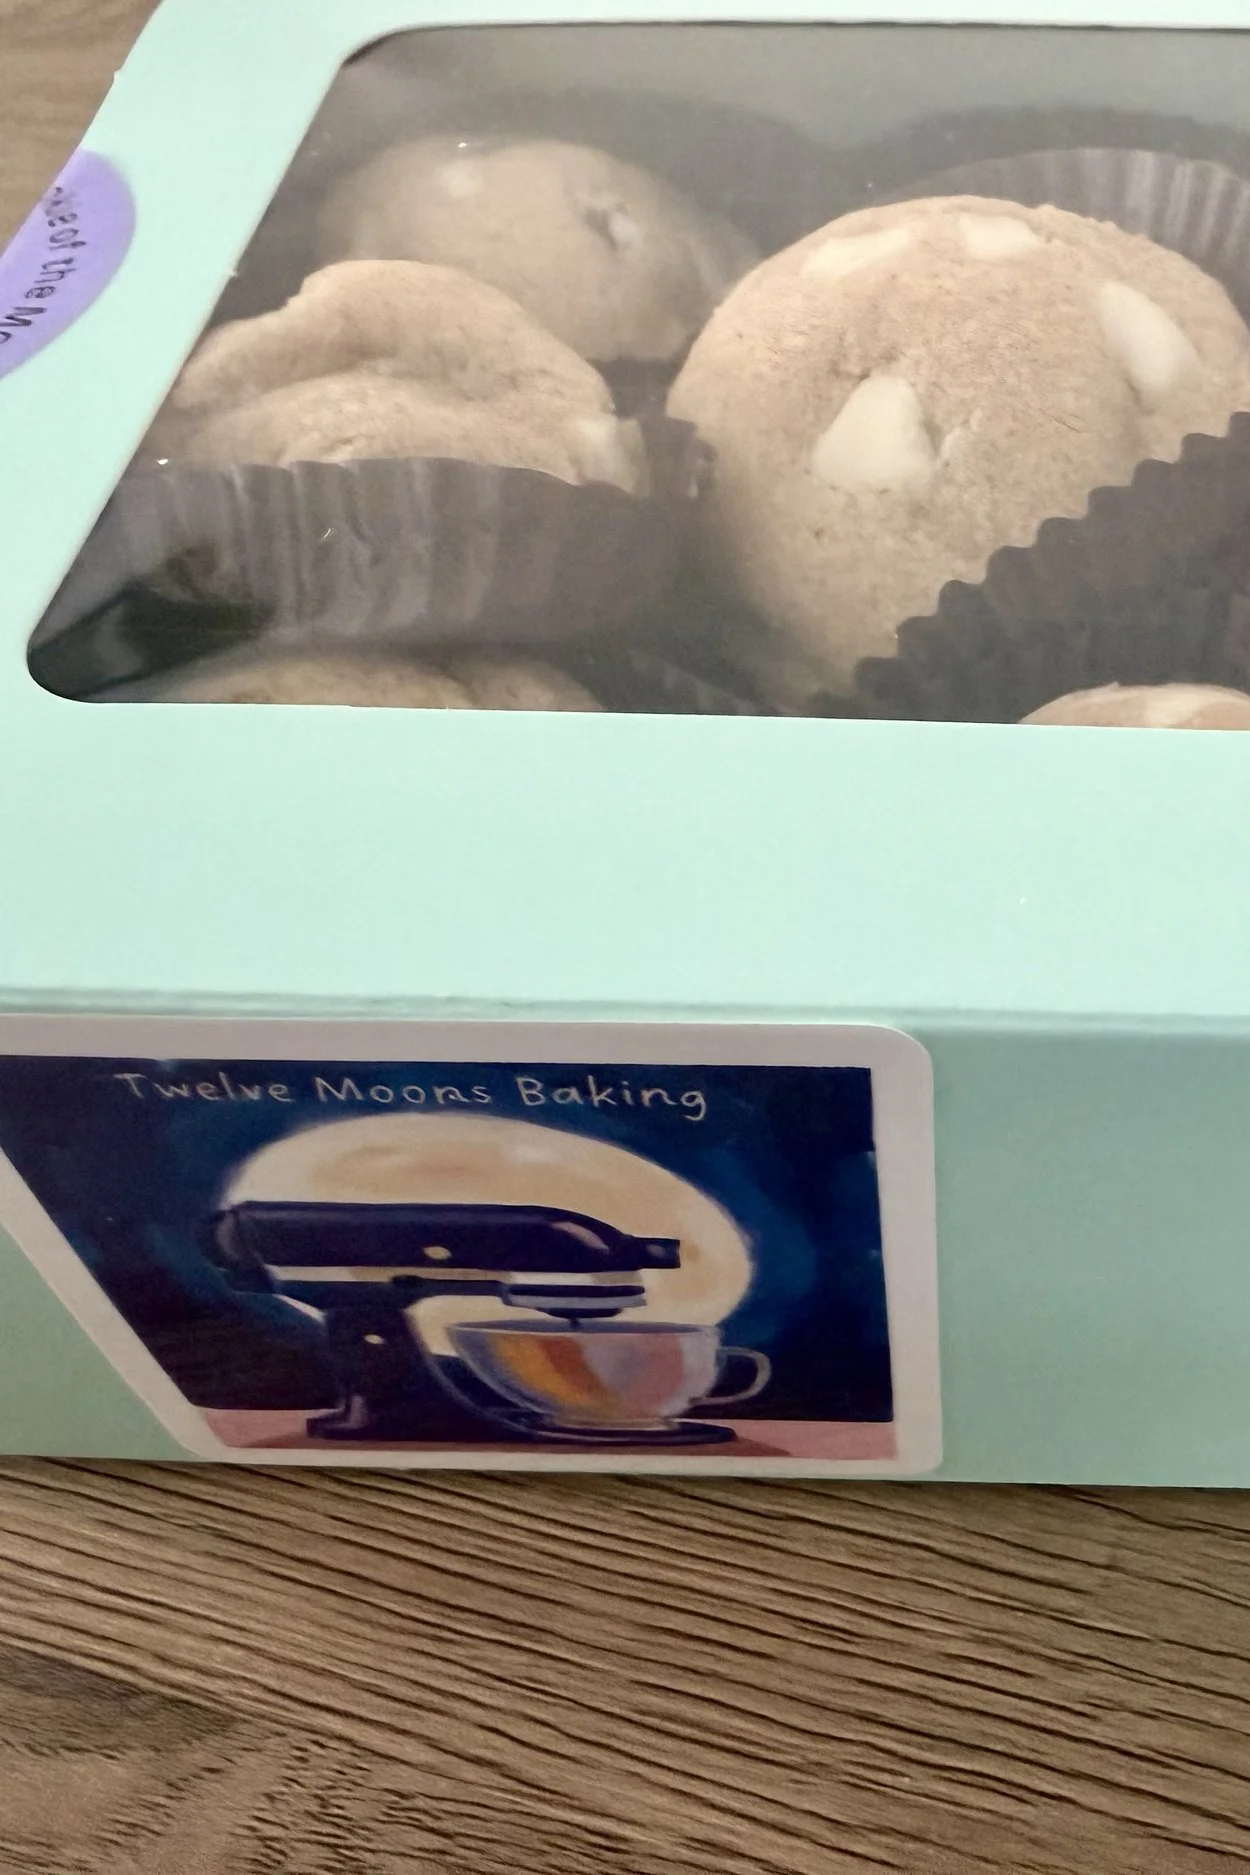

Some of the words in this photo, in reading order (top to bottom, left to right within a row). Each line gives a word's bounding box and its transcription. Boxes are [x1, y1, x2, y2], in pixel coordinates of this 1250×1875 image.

[48, 228, 88, 252] of
[24, 257, 77, 299] the
[112, 1071, 295, 1101] Twelve
[315, 1076, 492, 1104] Moons
[516, 1075, 707, 1121] Baking
